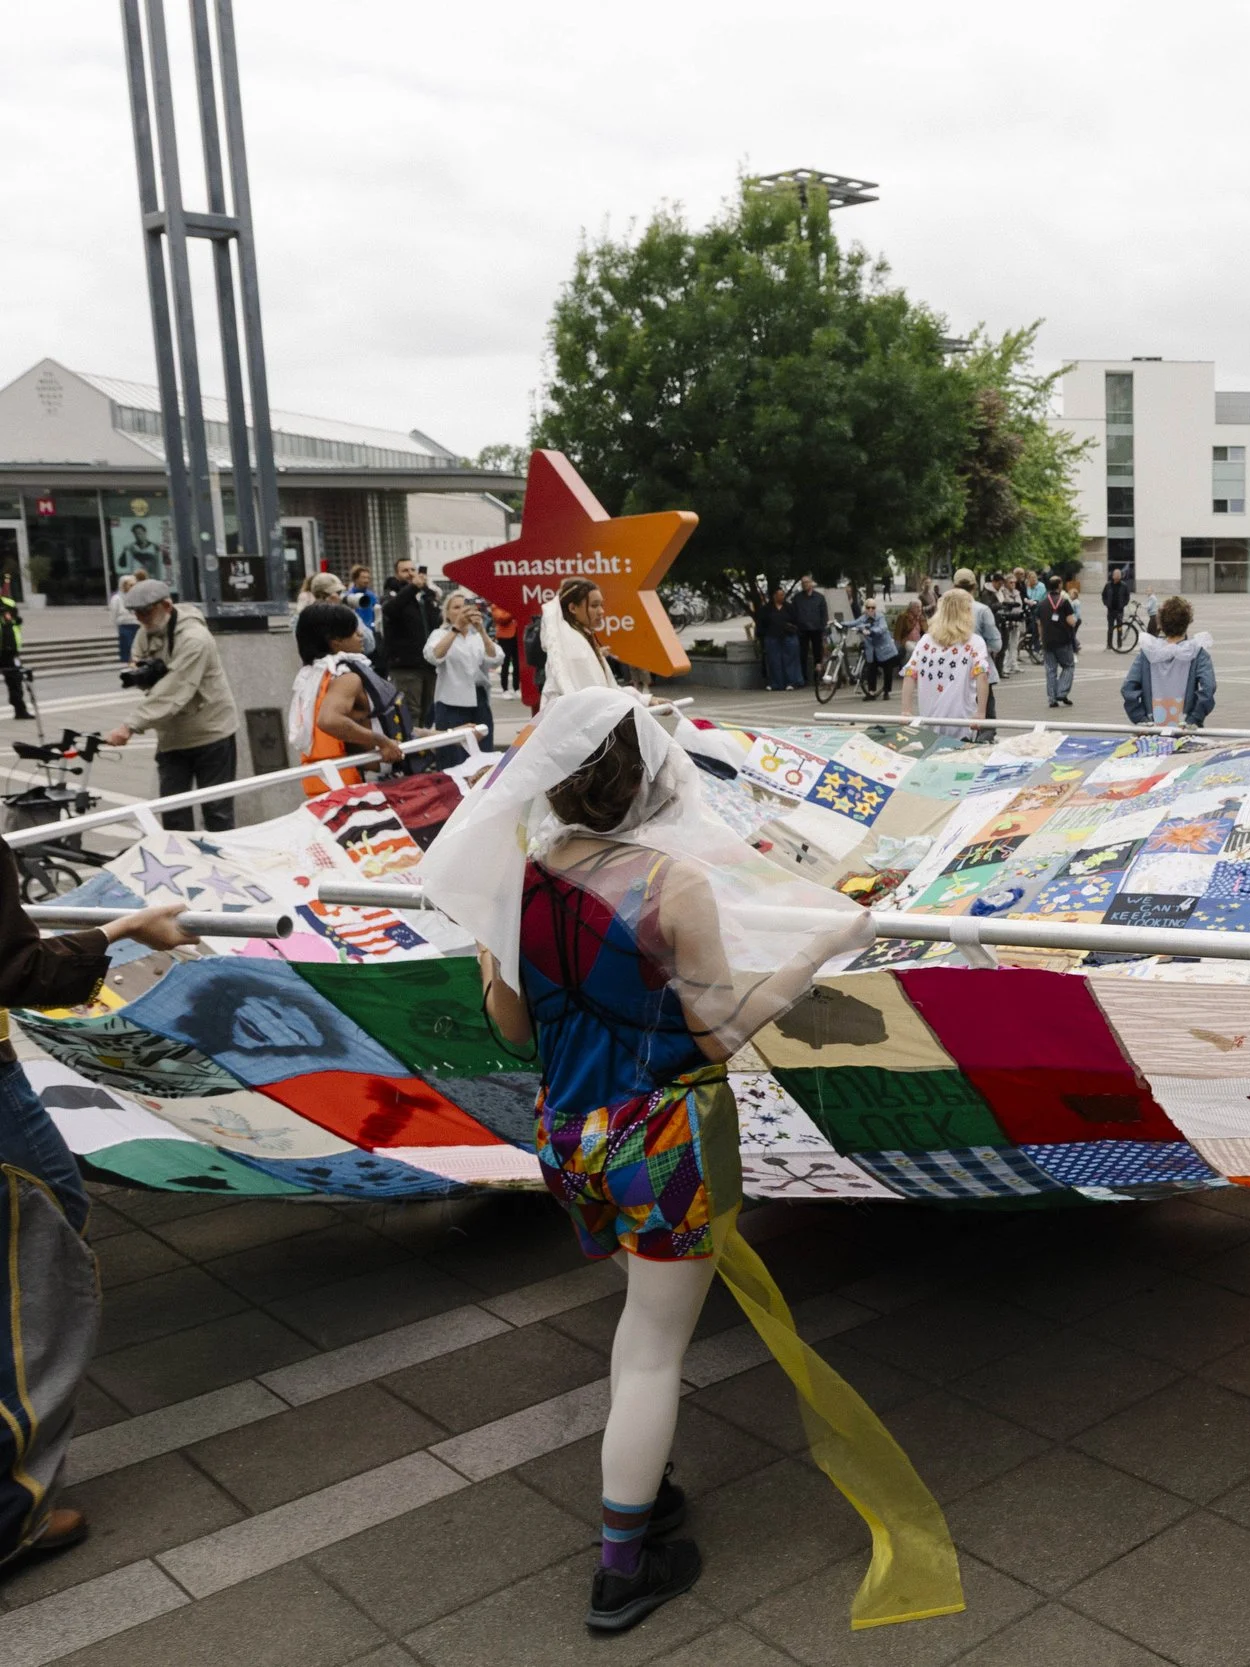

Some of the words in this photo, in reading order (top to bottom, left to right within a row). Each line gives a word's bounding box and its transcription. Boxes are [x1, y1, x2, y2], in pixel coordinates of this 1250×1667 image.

[493, 551, 632, 577] maastricht:
[1127, 896, 1153, 904] WE
[1110, 911, 1152, 920] KEEP
[1126, 918, 1186, 928] LOOKING
